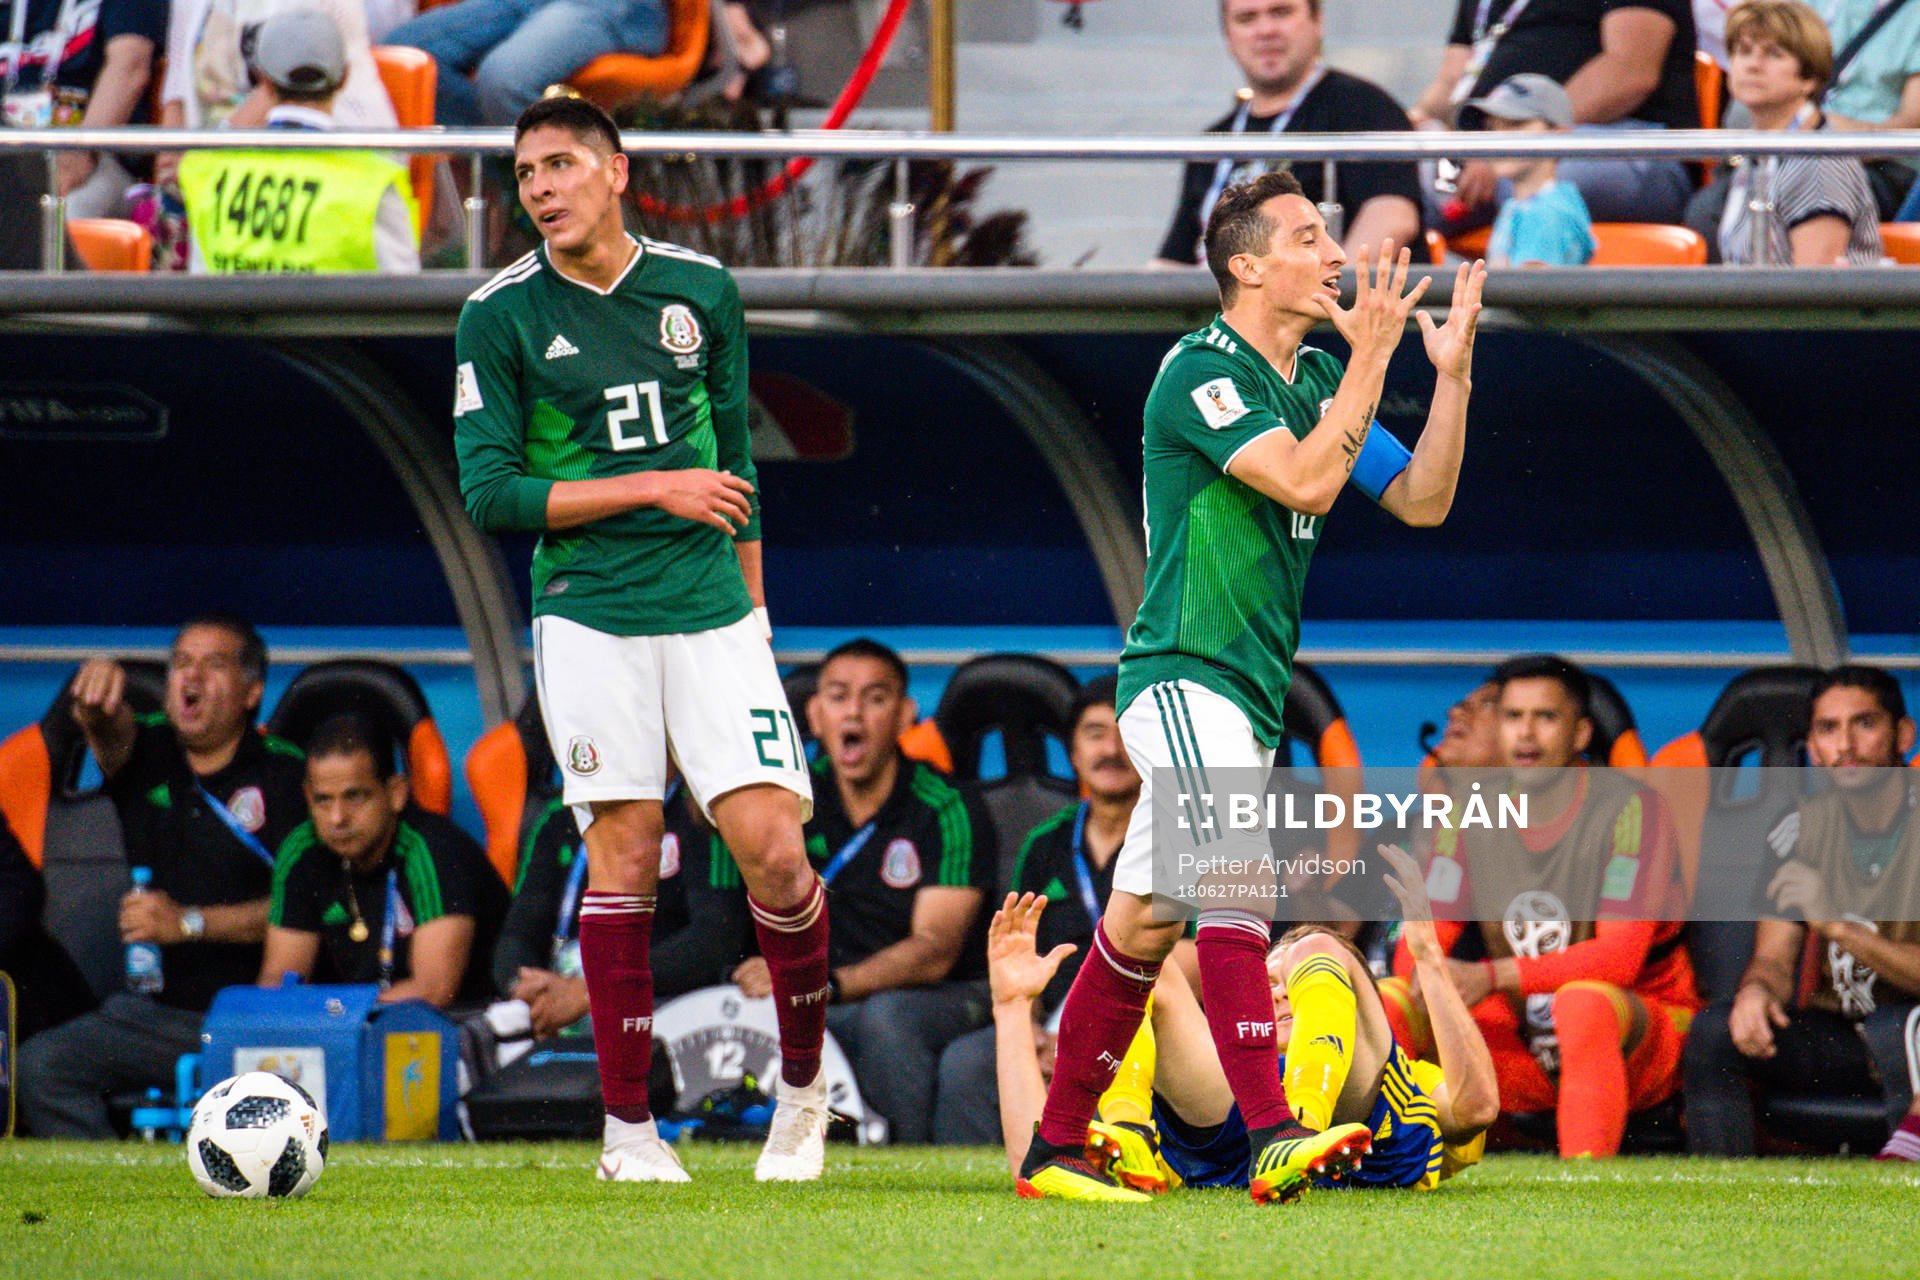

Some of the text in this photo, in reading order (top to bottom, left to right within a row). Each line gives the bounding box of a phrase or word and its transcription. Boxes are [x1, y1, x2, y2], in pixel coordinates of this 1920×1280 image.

[213, 168, 320, 243] 14687
[545, 346, 579, 360] adidas
[603, 380, 670, 451] 21
[749, 709, 800, 771] 21
[1236, 1021, 1274, 1039] FMF
[705, 1040, 747, 1079] 12
